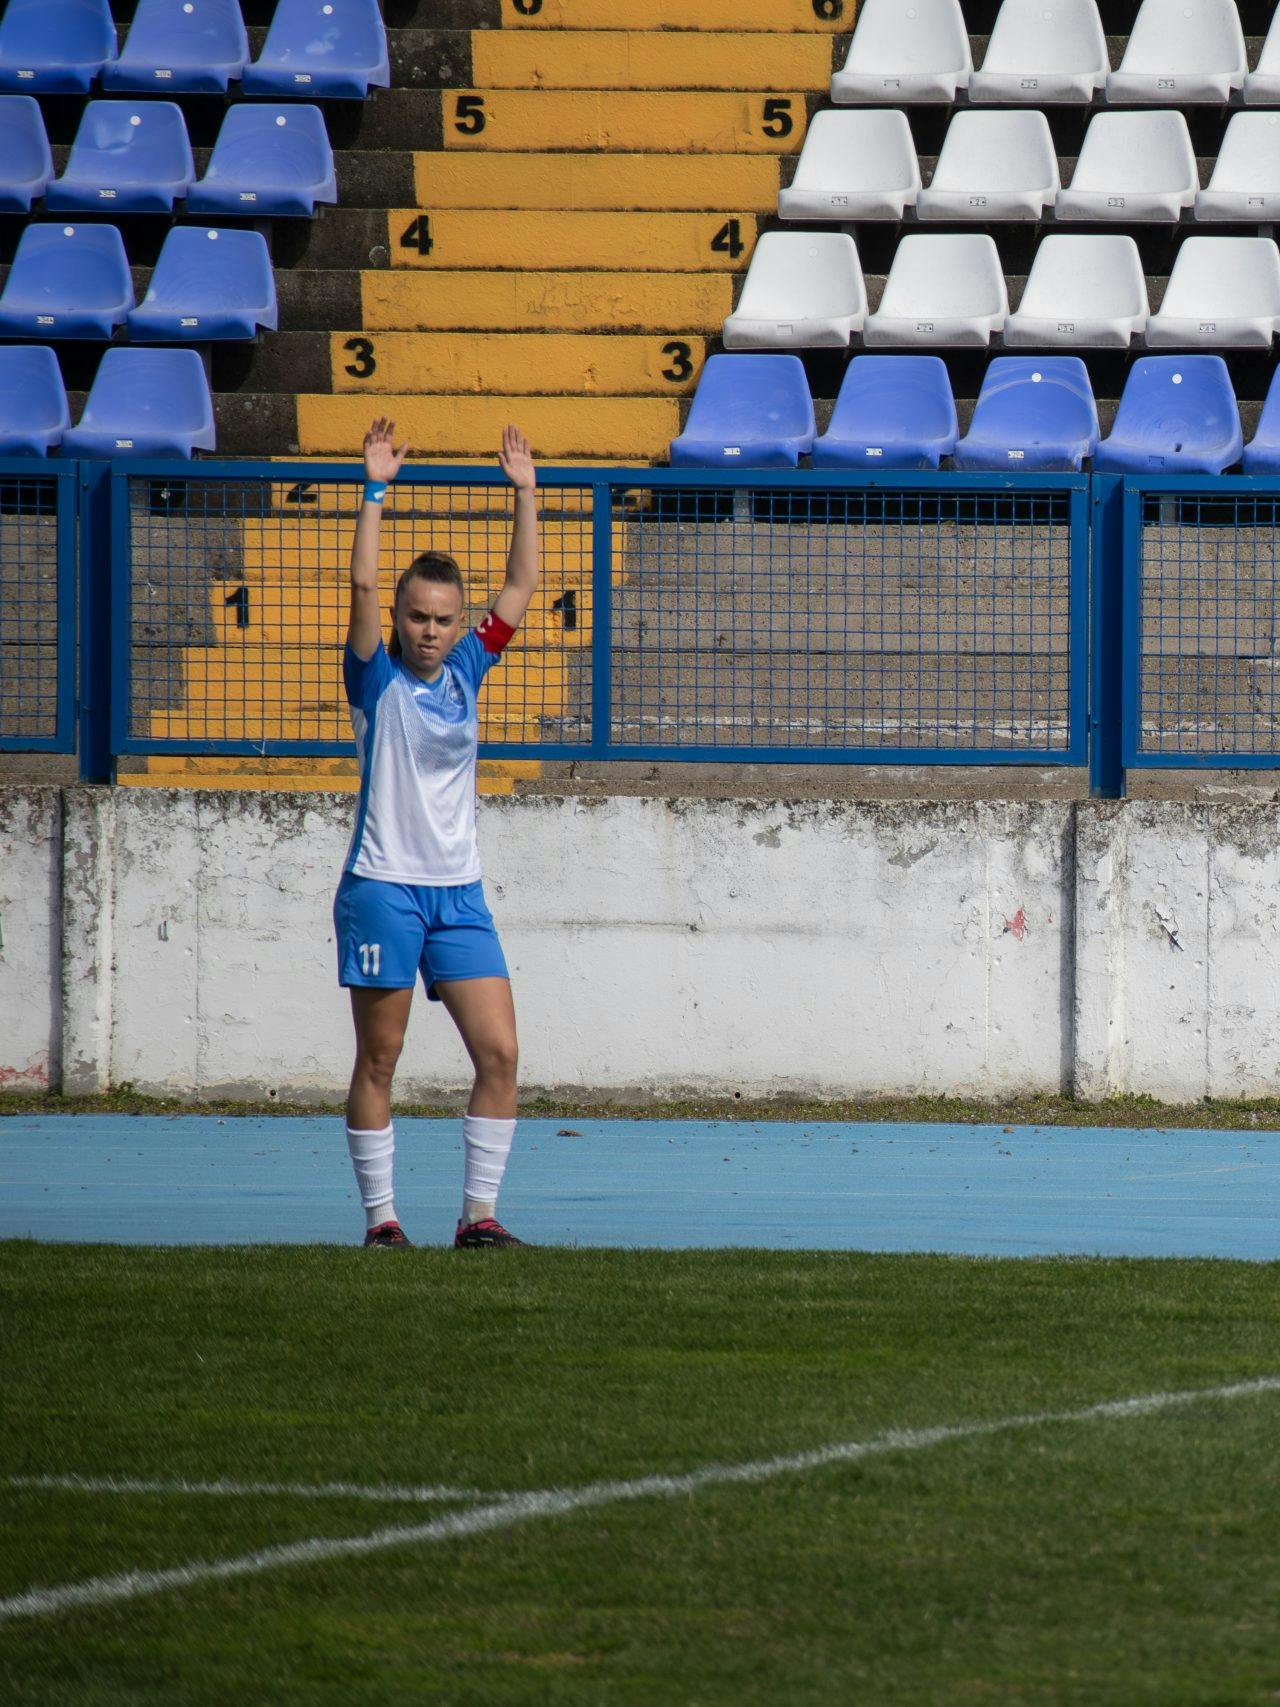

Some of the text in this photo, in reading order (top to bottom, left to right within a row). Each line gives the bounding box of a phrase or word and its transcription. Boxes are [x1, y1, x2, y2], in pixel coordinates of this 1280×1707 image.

[455, 96, 485, 135] 5
[763, 98, 792, 138] 5
[400, 214, 433, 256] 4
[711, 218, 744, 259] 4
[344, 338, 376, 378] 3
[662, 342, 694, 382] 3
[226, 587, 250, 628] 1
[553, 590, 577, 631] 1
[359, 943, 380, 976] 11
